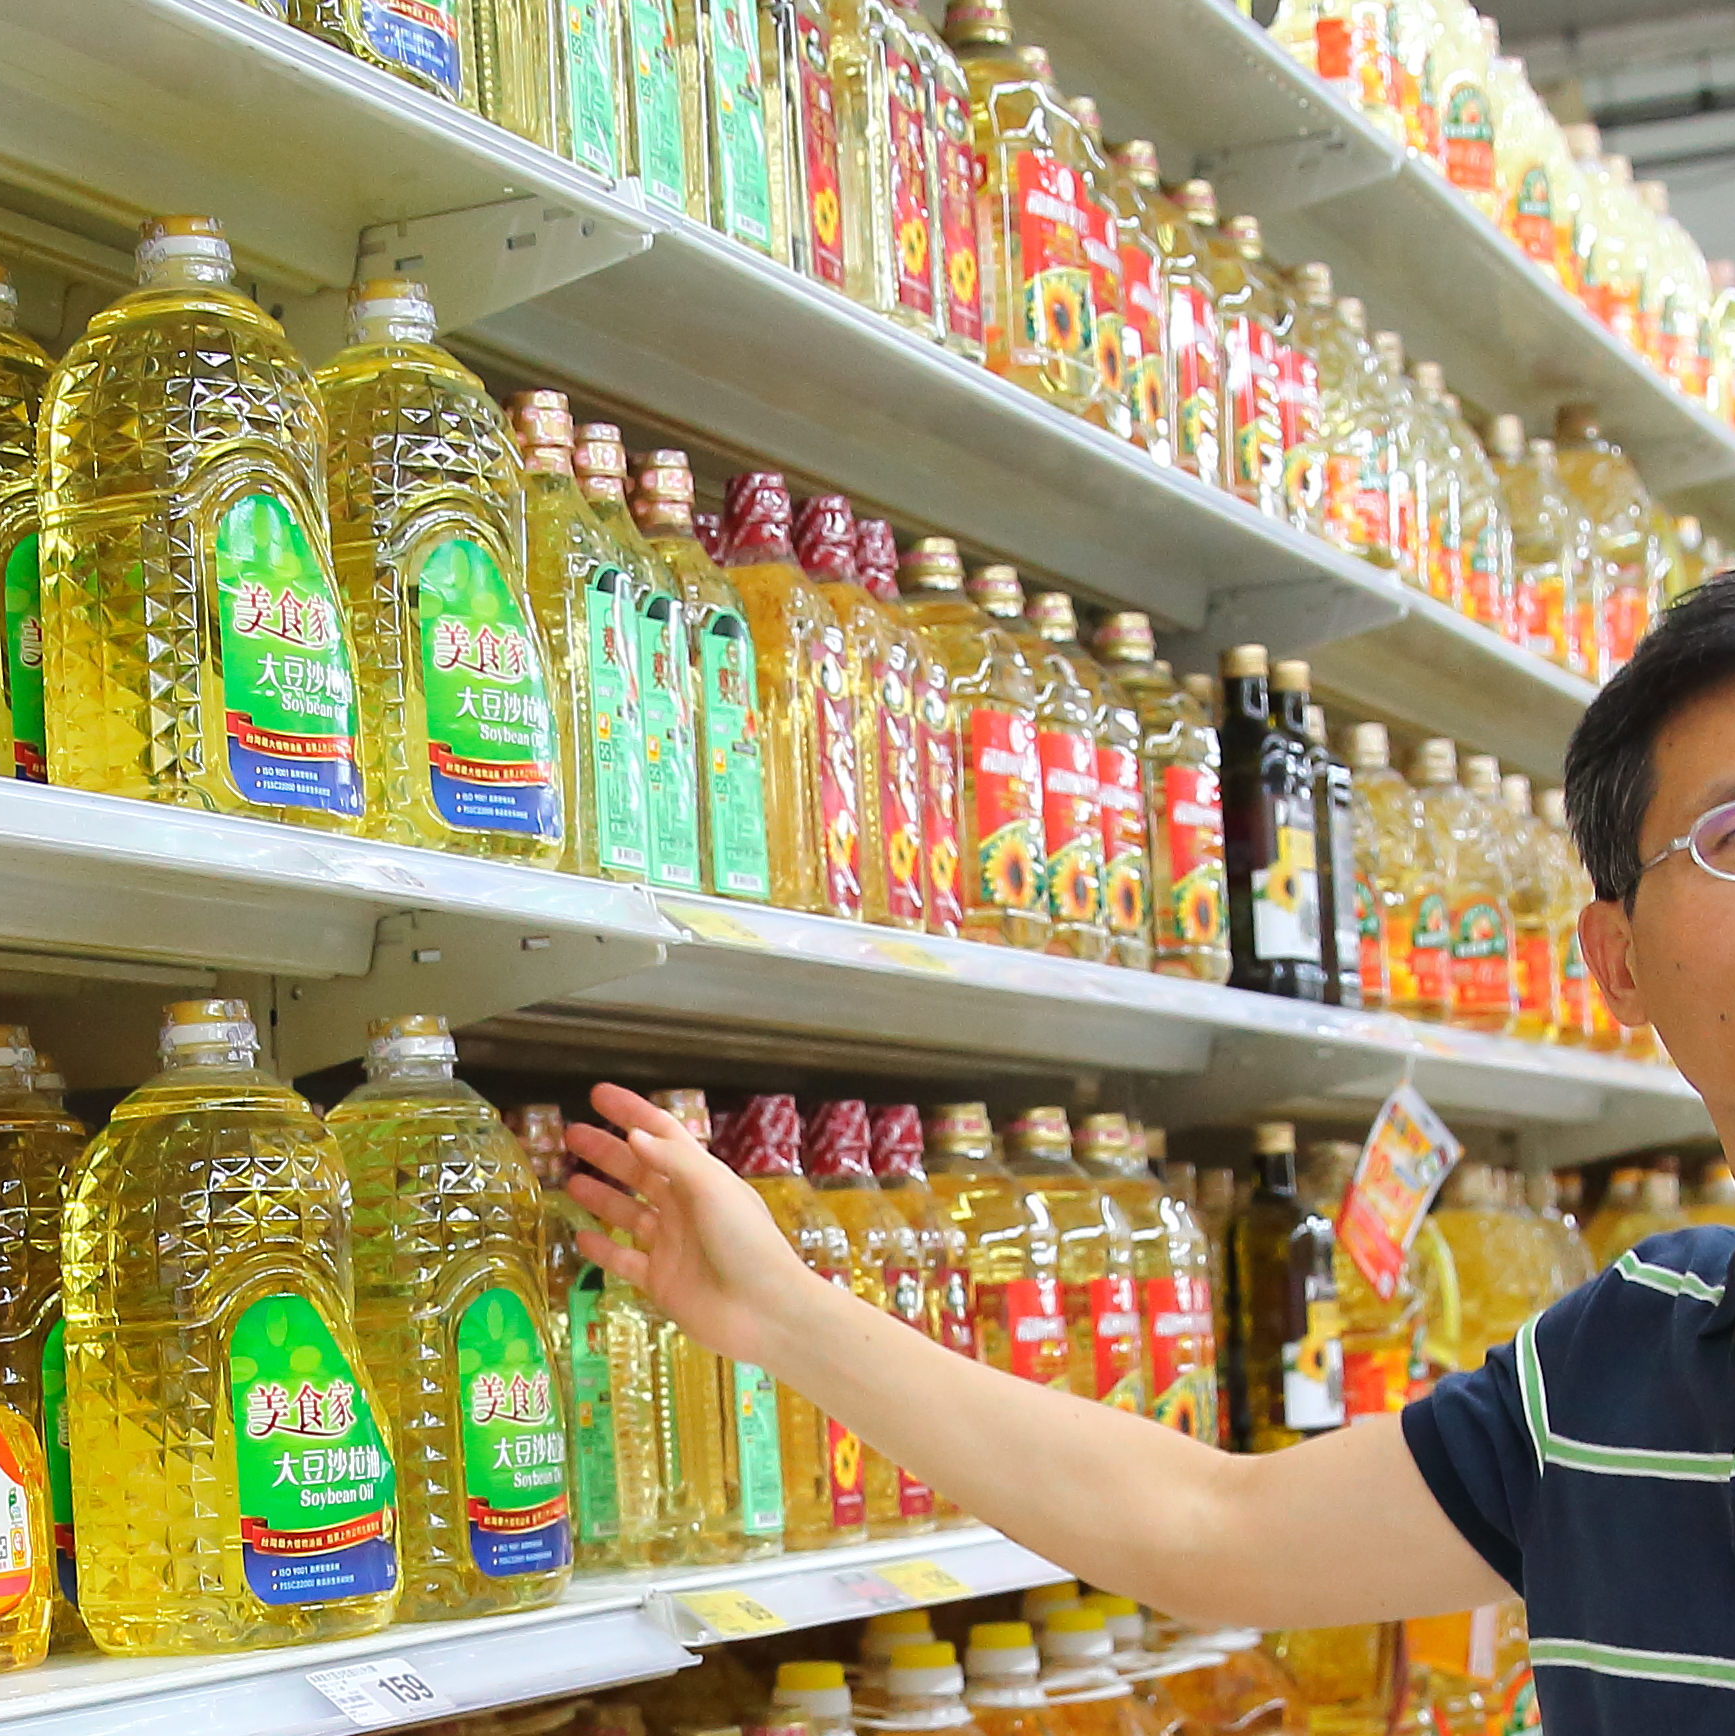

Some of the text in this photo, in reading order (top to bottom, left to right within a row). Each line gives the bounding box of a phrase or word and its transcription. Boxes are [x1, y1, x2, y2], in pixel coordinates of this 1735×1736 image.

[233, 585, 332, 648] 美食家
[434, 621, 528, 682] 美食家
[282, 692, 333, 718] Soybean
[478, 722, 528, 748] Soybean
[246, 1382, 355, 1438] 美食家
[473, 1372, 551, 1425] 美食家
[272, 1448, 381, 1486] 大豆沙拉油
[300, 1483, 374, 1509] Soybean Oil
[378, 1673, 434, 1704] 159
